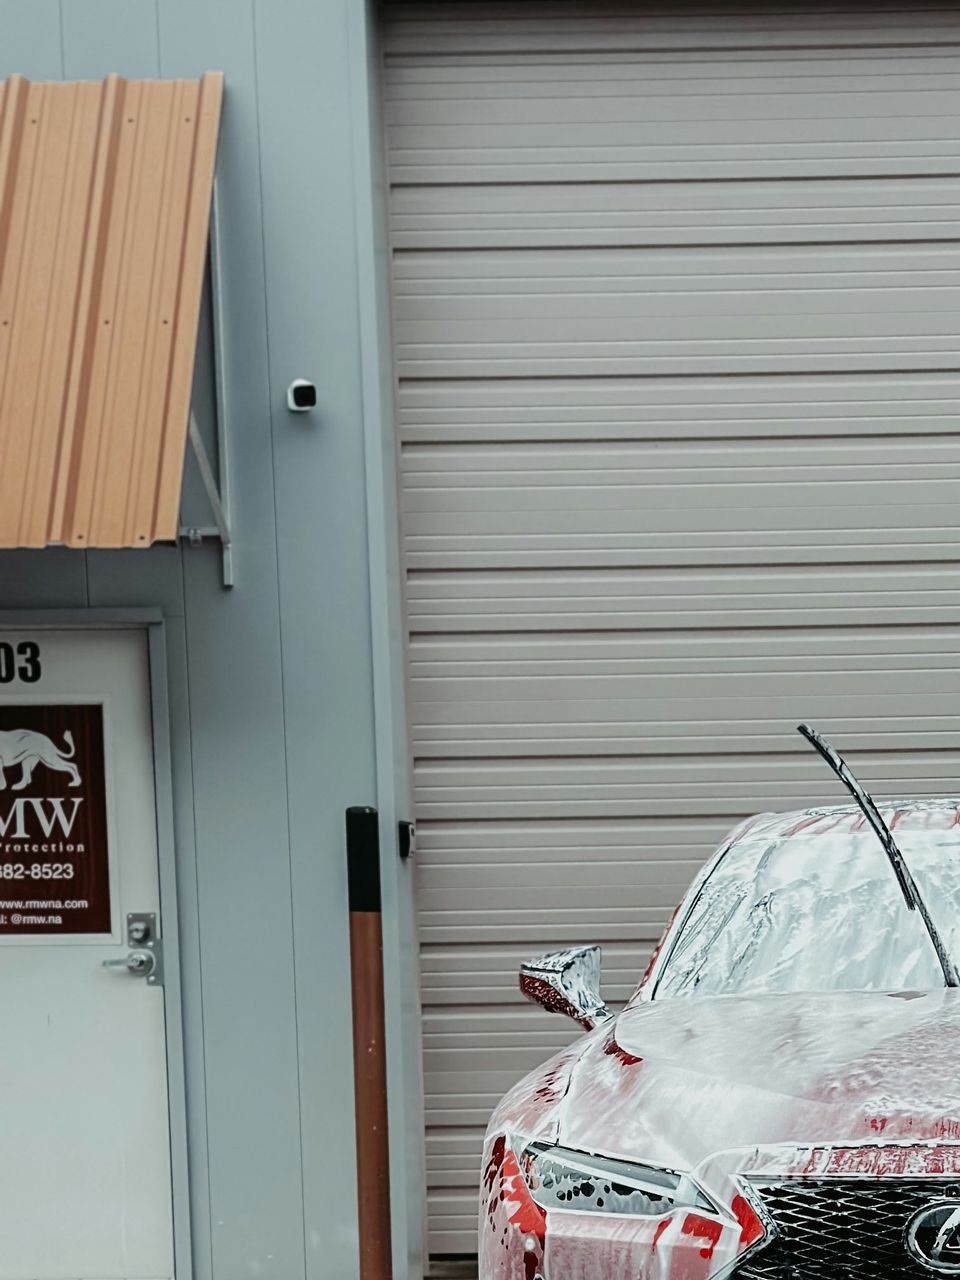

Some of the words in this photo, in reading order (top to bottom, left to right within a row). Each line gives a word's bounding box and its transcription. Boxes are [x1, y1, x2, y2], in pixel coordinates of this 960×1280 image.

[0, 641, 42, 683] 03
[0, 842, 85, 853] rotection
[0, 863, 74, 880] 82-8523
[10, 913, 63, 925] @rmw.na
